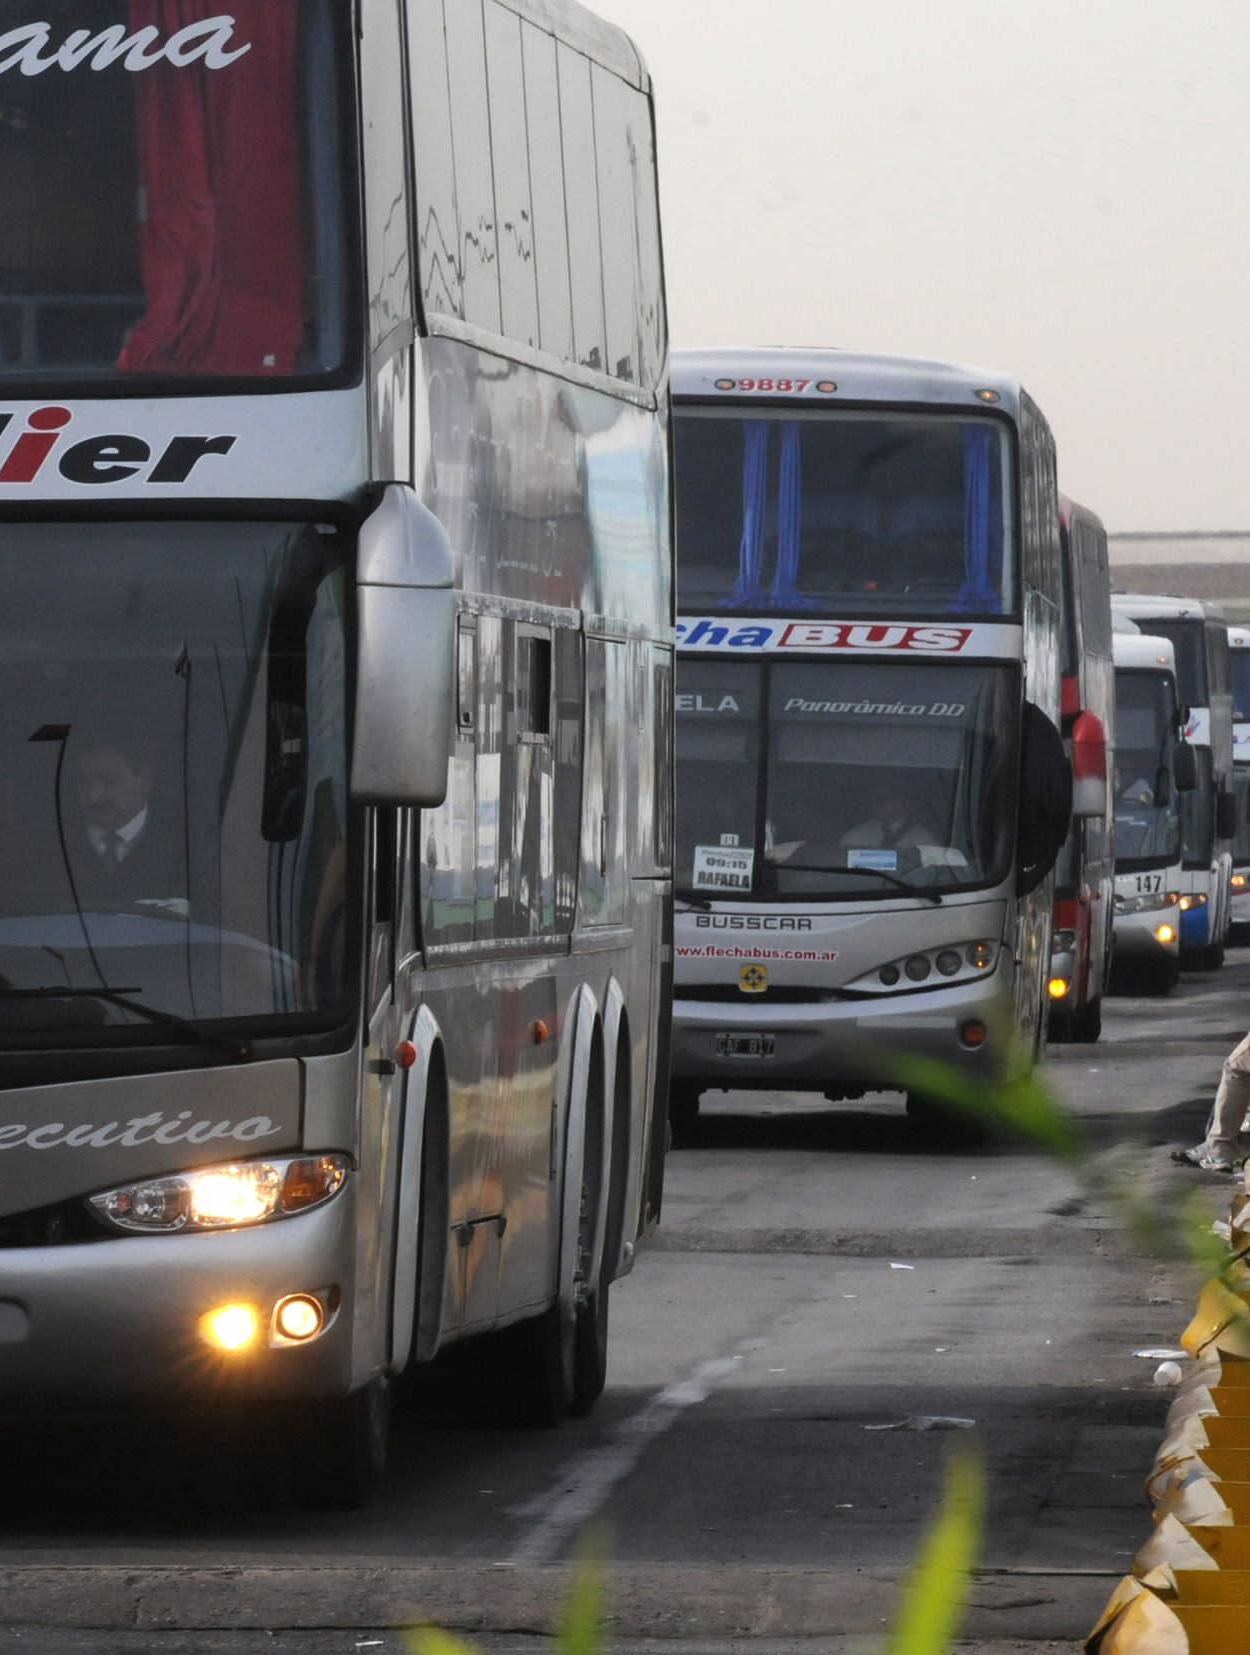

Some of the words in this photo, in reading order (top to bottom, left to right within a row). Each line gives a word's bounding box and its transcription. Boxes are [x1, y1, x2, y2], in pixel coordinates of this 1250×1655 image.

[738, 377, 811, 393] 9887
[928, 702, 965, 717] DD
[706, 857, 748, 870] 09:15
[697, 871, 750, 888] RAFAELA
[1135, 875, 1162, 893] 147
[696, 916, 812, 931] BUSSCAR
[675, 945, 837, 961] ww.flechabus.com.ar
